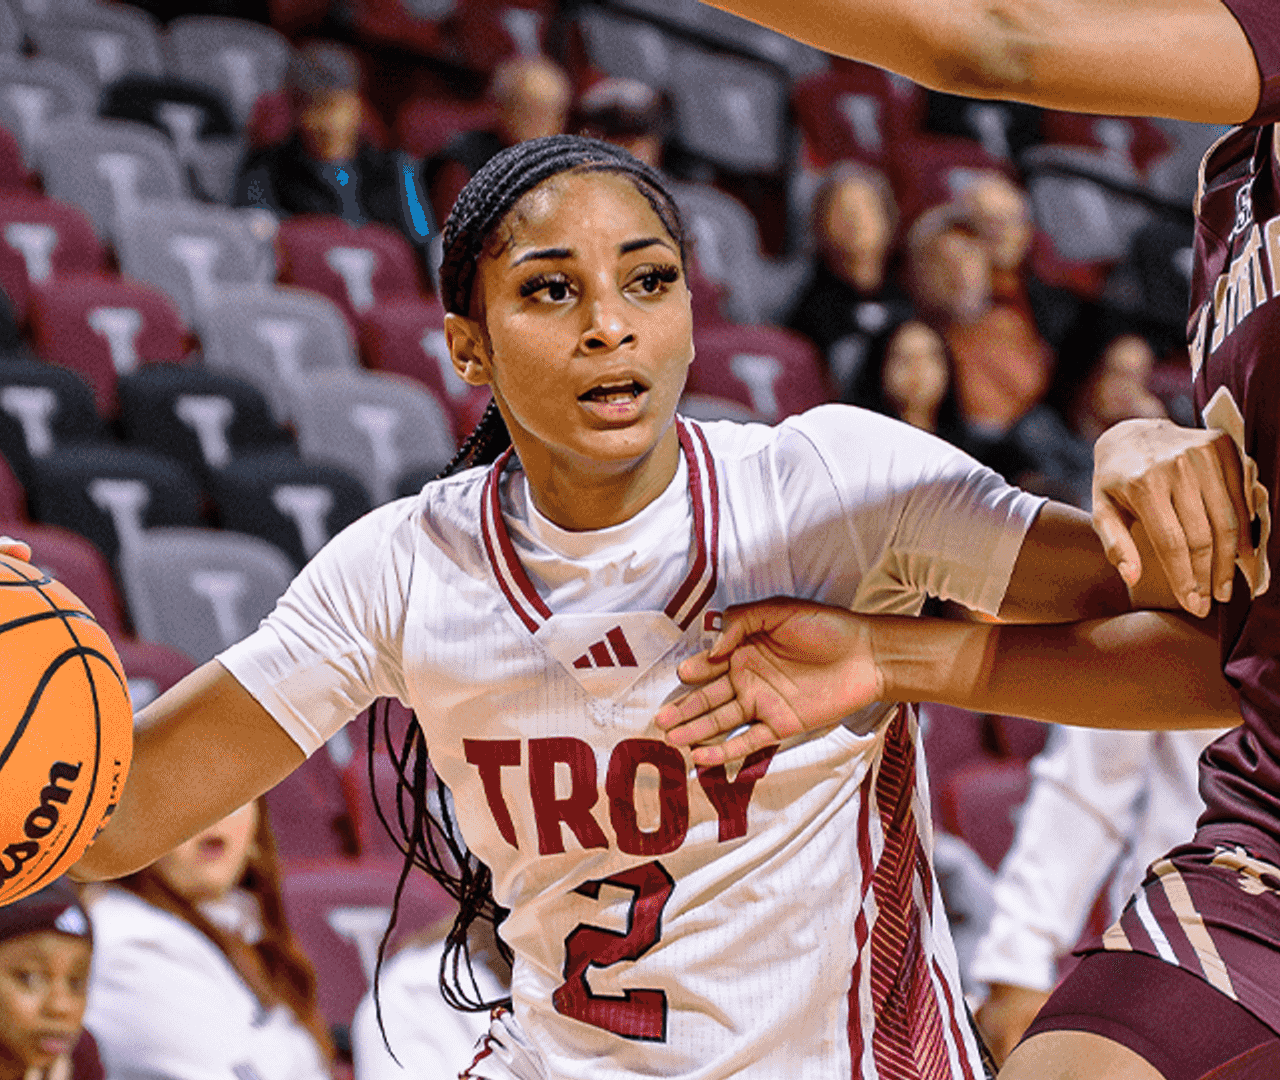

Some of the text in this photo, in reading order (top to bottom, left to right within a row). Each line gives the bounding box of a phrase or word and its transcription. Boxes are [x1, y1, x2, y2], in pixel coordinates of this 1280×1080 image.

[5, 223, 57, 283] T
[171, 238, 218, 300] T
[324, 247, 376, 312] T
[87, 308, 141, 375] T
[258, 320, 304, 385] T
[0, 387, 57, 453] T
[177, 395, 233, 468] T
[350, 405, 400, 500] T
[87, 479, 150, 552] T
[273, 486, 332, 555] T
[190, 572, 245, 640] T
[462, 737, 781, 857] TROY
[328, 907, 393, 990] T
[552, 860, 677, 1044] 2
